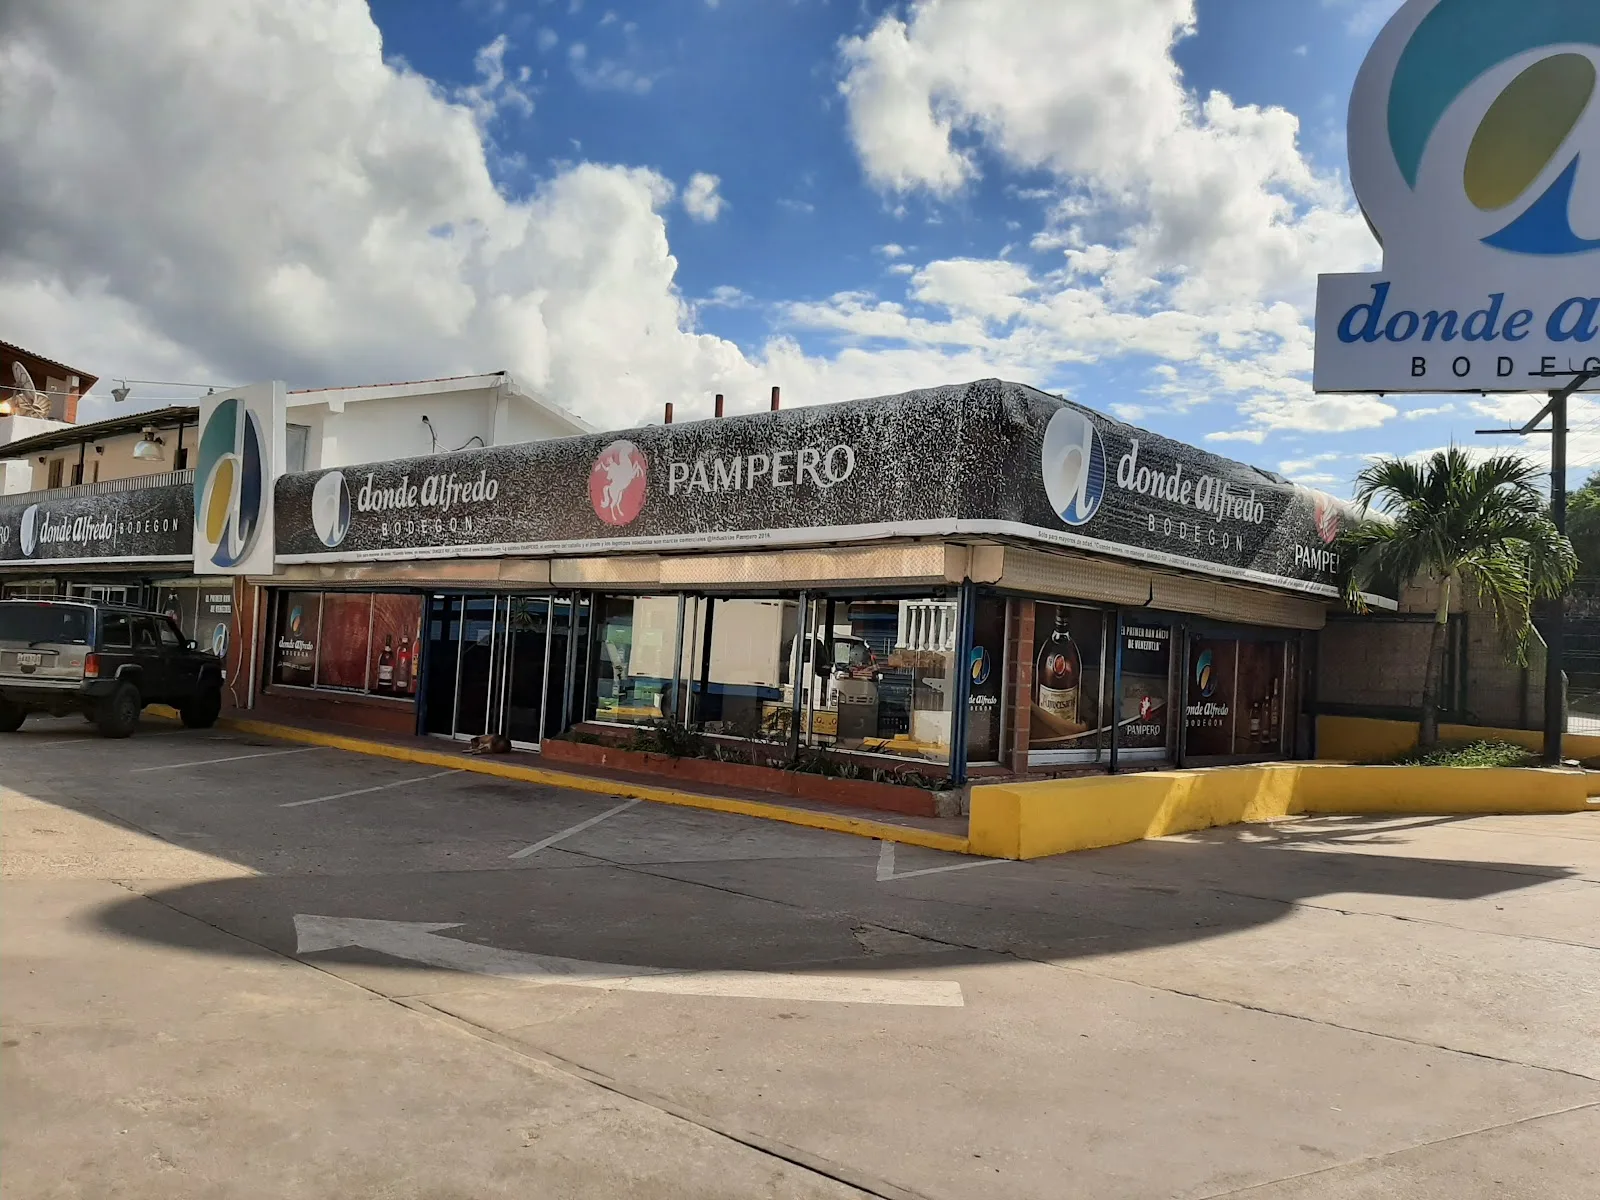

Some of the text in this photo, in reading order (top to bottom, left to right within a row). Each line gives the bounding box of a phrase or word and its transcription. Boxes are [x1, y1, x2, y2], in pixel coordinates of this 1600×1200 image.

[1337, 281, 1533, 343] donde
[668, 444, 855, 496] PAMPERO
[1116, 439, 1264, 525] donde alfredo
[357, 470, 498, 512] donde alfredo
[40, 511, 178, 547] donde alfredo BODEGON
[382, 517, 473, 536] BODEGON
[1148, 513, 1243, 551] BODEGON
[1295, 545, 1339, 574] PAMPE
[1126, 725, 1161, 736] PAMPERO
